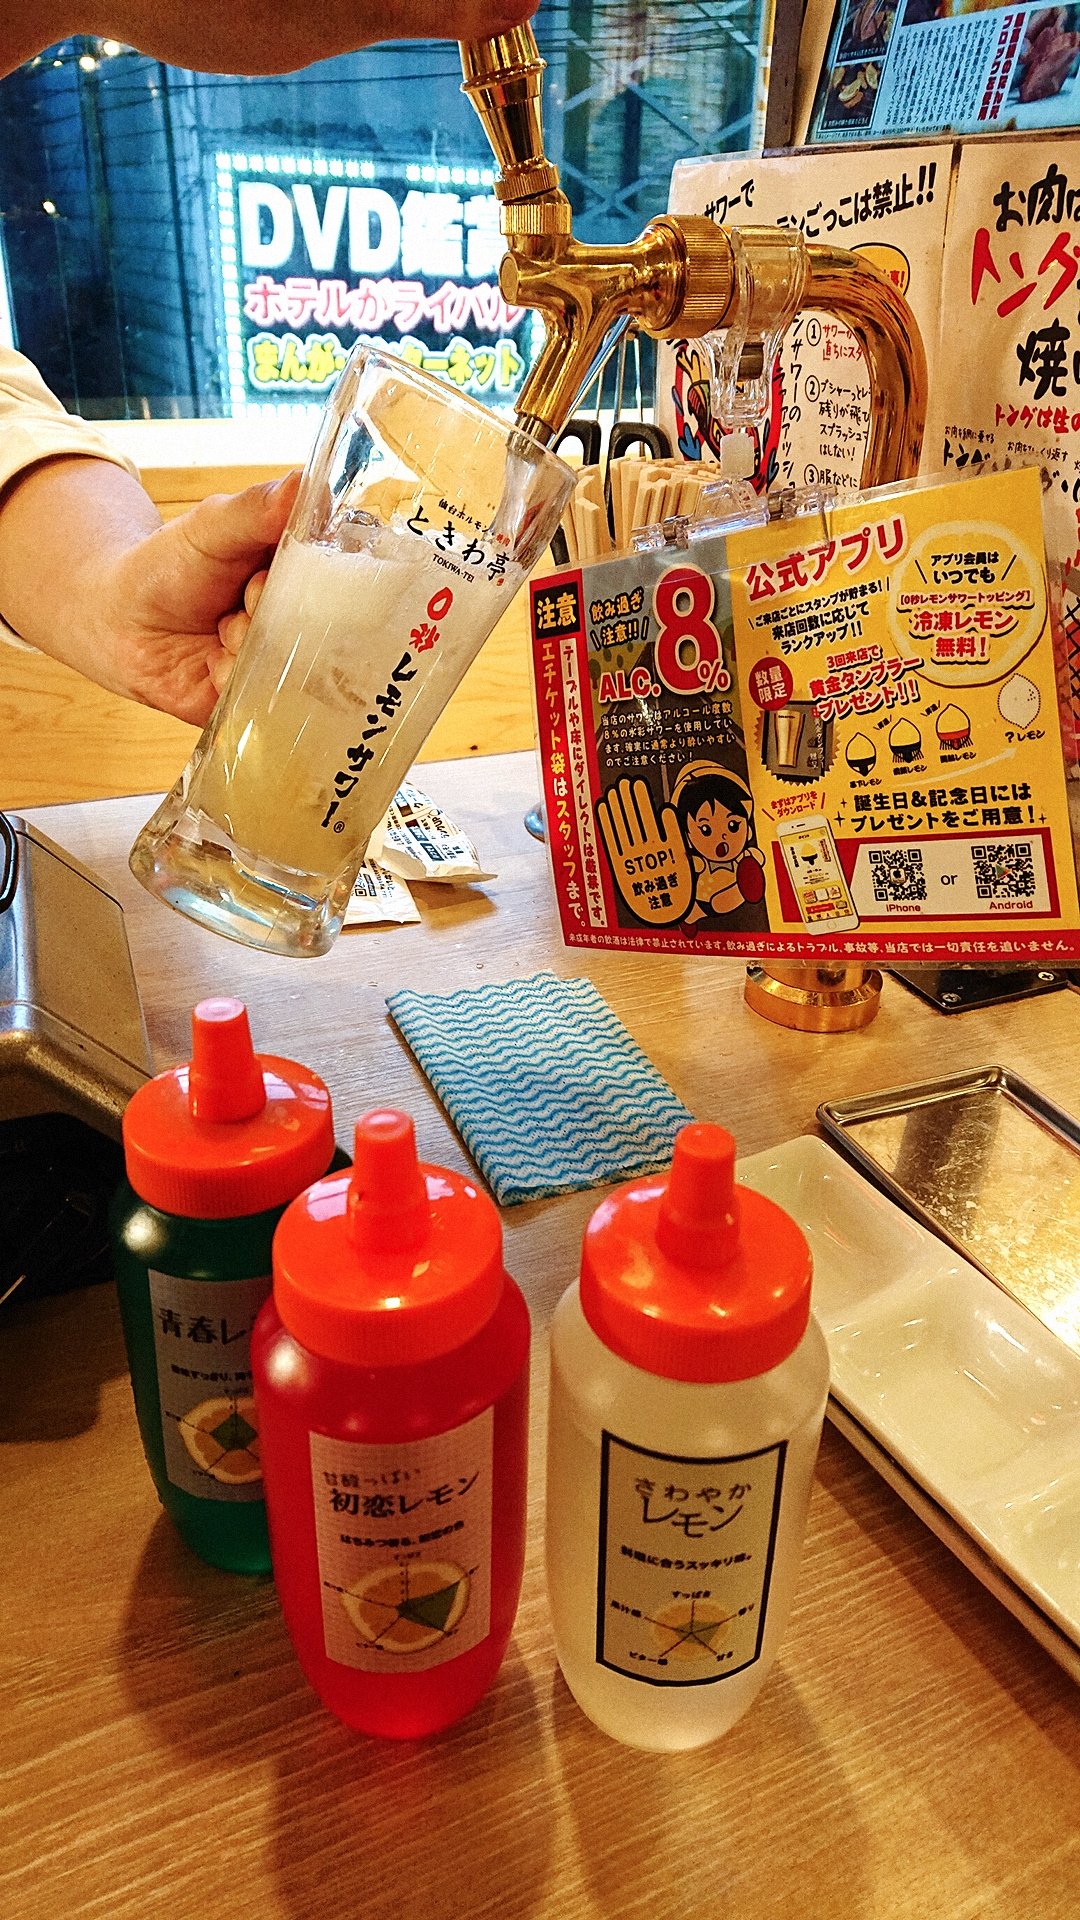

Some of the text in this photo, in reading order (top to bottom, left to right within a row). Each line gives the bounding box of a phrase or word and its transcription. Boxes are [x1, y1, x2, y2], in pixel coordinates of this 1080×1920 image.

[406, 506, 510, 582] ときわ亭
[432, 554, 475, 583] TOKIWA-TEI
[746, 518, 904, 602] 公式アプリ
[931, 551, 999, 566] アプリ会員は
[933, 567, 996, 584] いつでも
[537, 593, 577, 629] 注意
[592, 587, 644, 622] 飲み過ぎ
[772, 601, 870, 640] 来店回数に応じて
[913, 610, 1014, 632] 冷凍レモン
[826, 645, 880, 668] 3回来店で
[754, 666, 783, 686] 数量
[809, 657, 921, 700] 黄金タンブラー
[758, 682, 788, 704] 限定
[777, 802, 816, 817] ダウンロード
[624, 848, 677, 875] STOP!
[632, 873, 678, 898] 飲み過ぎ
[940, 874, 957, 887] or
[648, 893, 673, 909] 注意
[886, 903, 921, 913] iPhone
[989, 900, 1034, 911] Android
[329, 1471, 479, 1517] 初恋レモン
[634, 1477, 751, 1502] さわやか
[643, 1496, 743, 1538] レモン
